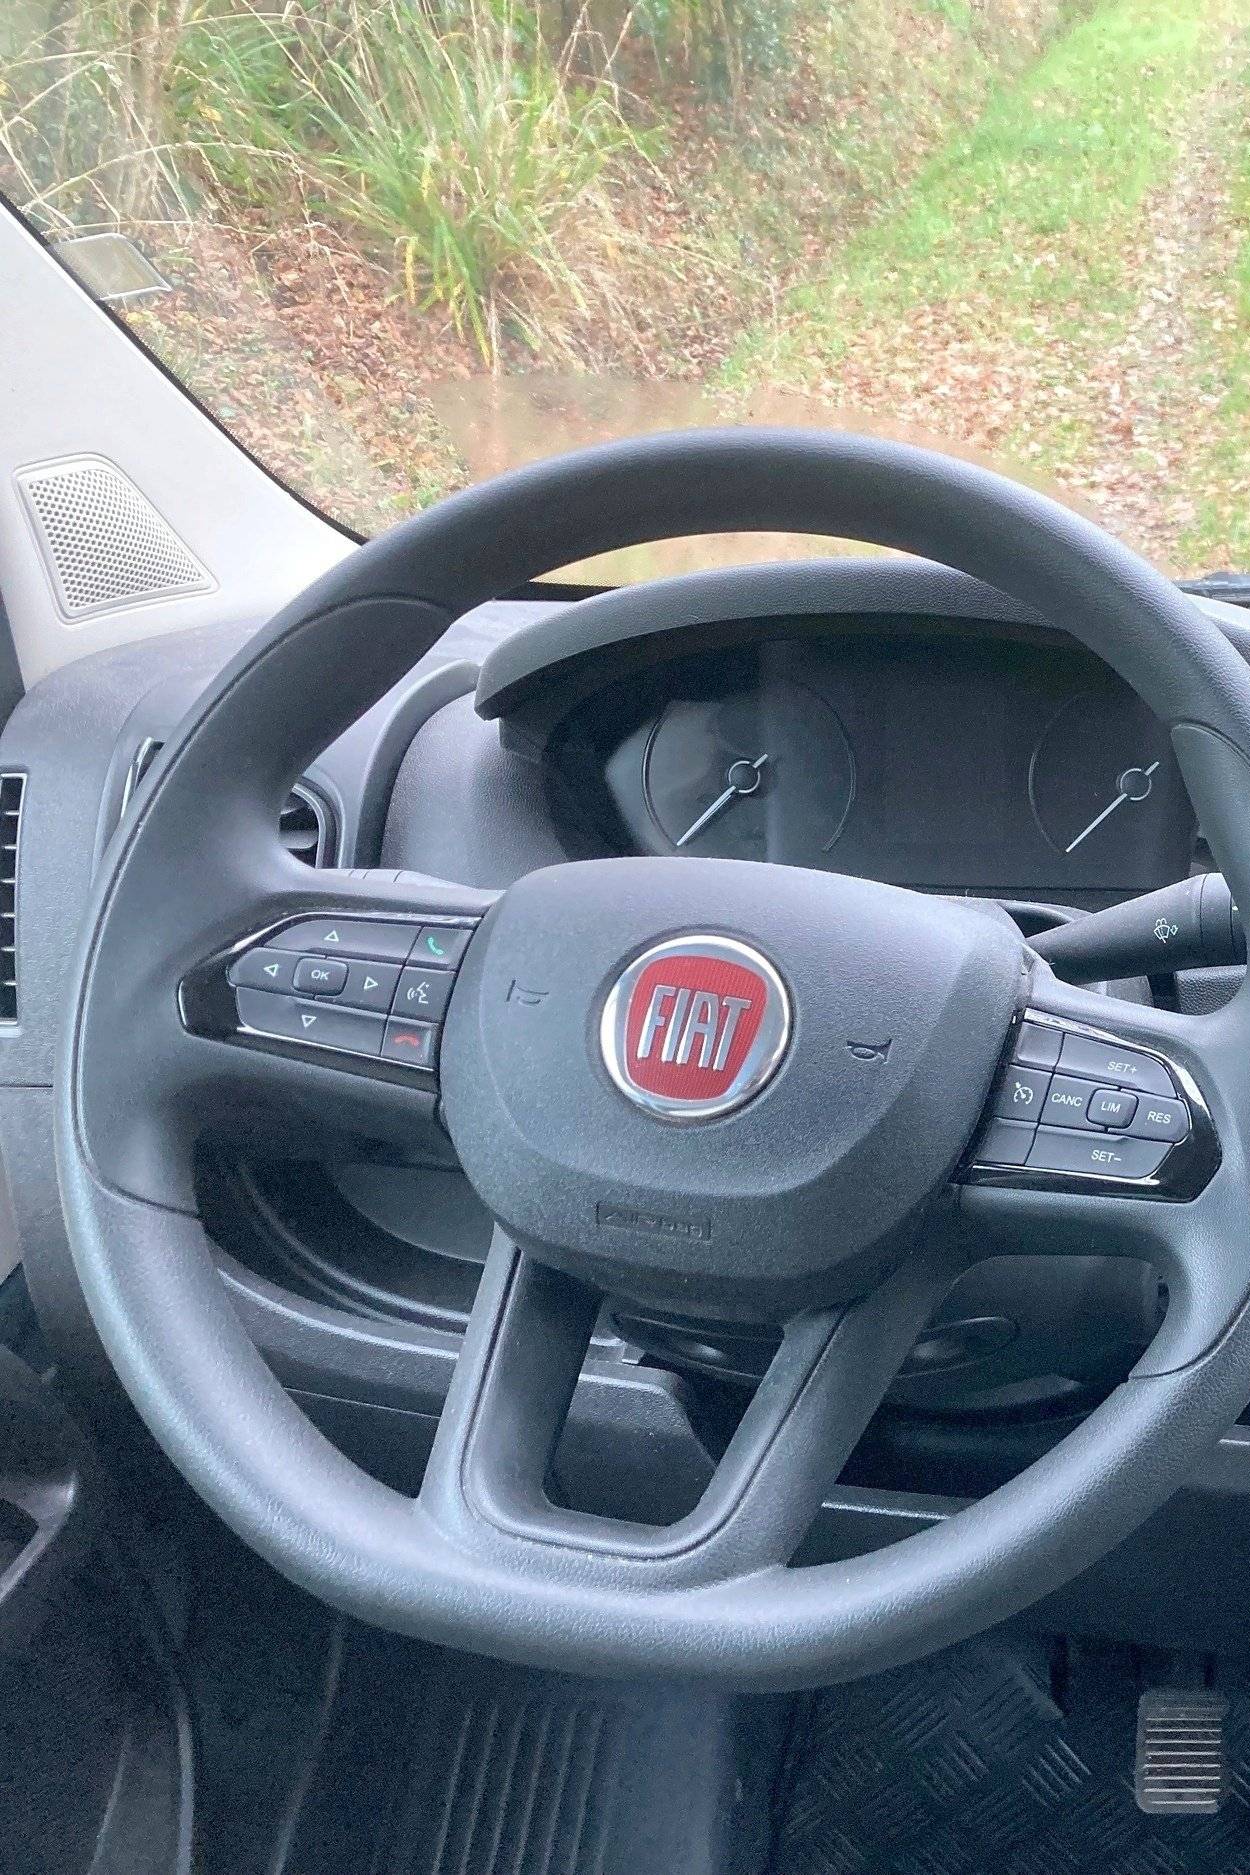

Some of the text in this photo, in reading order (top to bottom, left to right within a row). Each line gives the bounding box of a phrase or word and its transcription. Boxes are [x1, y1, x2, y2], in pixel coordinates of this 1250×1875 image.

[310, 969, 330, 980] OK
[636, 983, 753, 1072] FIAT
[1106, 1060, 1138, 1075] SET+
[1051, 1092, 1083, 1108] CANC
[1100, 1100, 1121, 1114] LIM
[1147, 1110, 1171, 1125] RES
